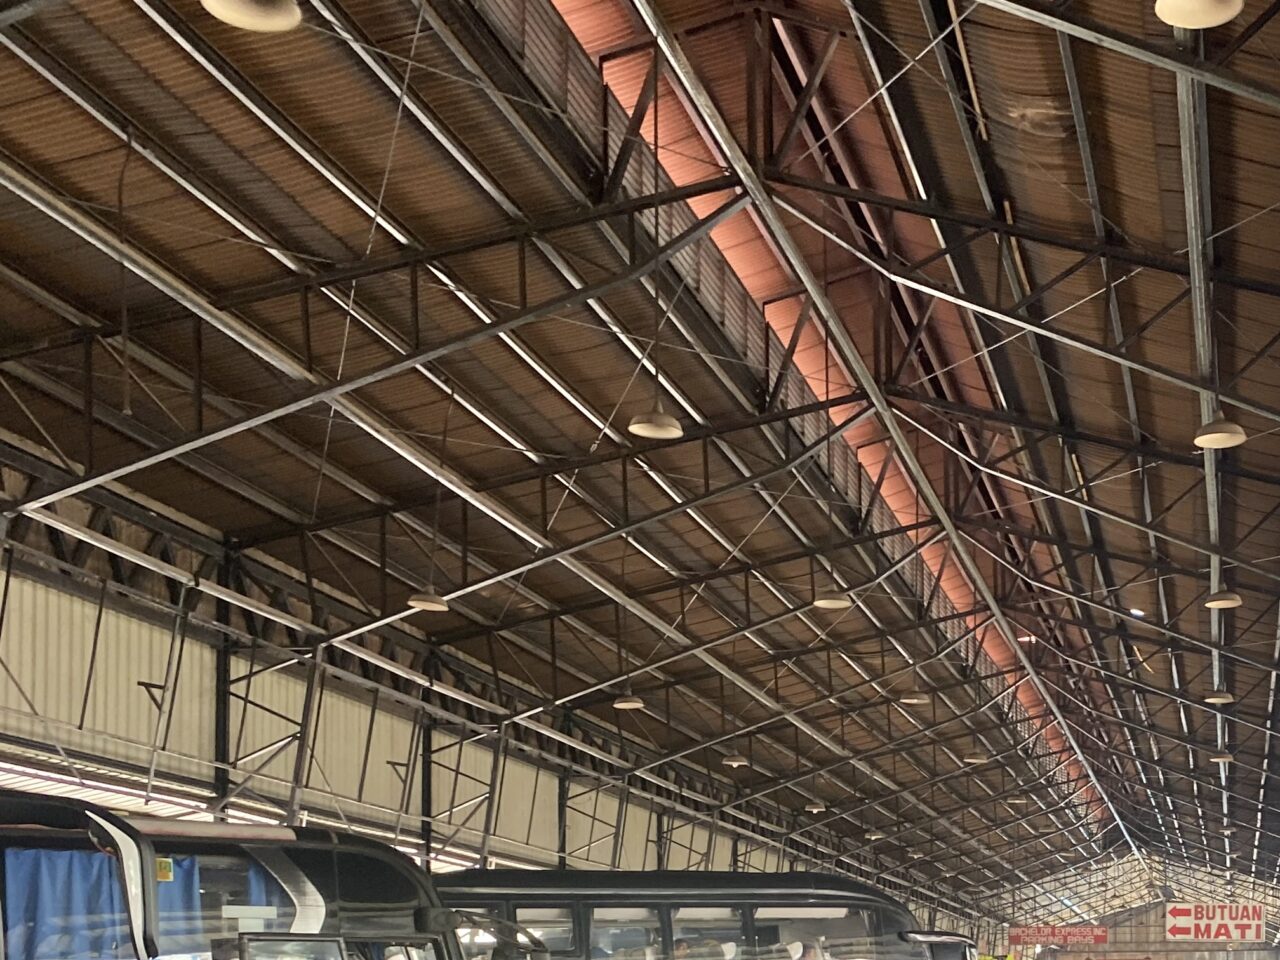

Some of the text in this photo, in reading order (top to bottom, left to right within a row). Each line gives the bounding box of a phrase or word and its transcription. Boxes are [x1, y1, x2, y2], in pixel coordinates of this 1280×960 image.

[1193, 904, 1263, 922] BUTUAN
[1010, 926, 1052, 936] BACHELOR
[1055, 926, 1092, 936] EXPRESS
[1193, 922, 1263, 940] MATI
[1067, 935, 1095, 944] BAYS
